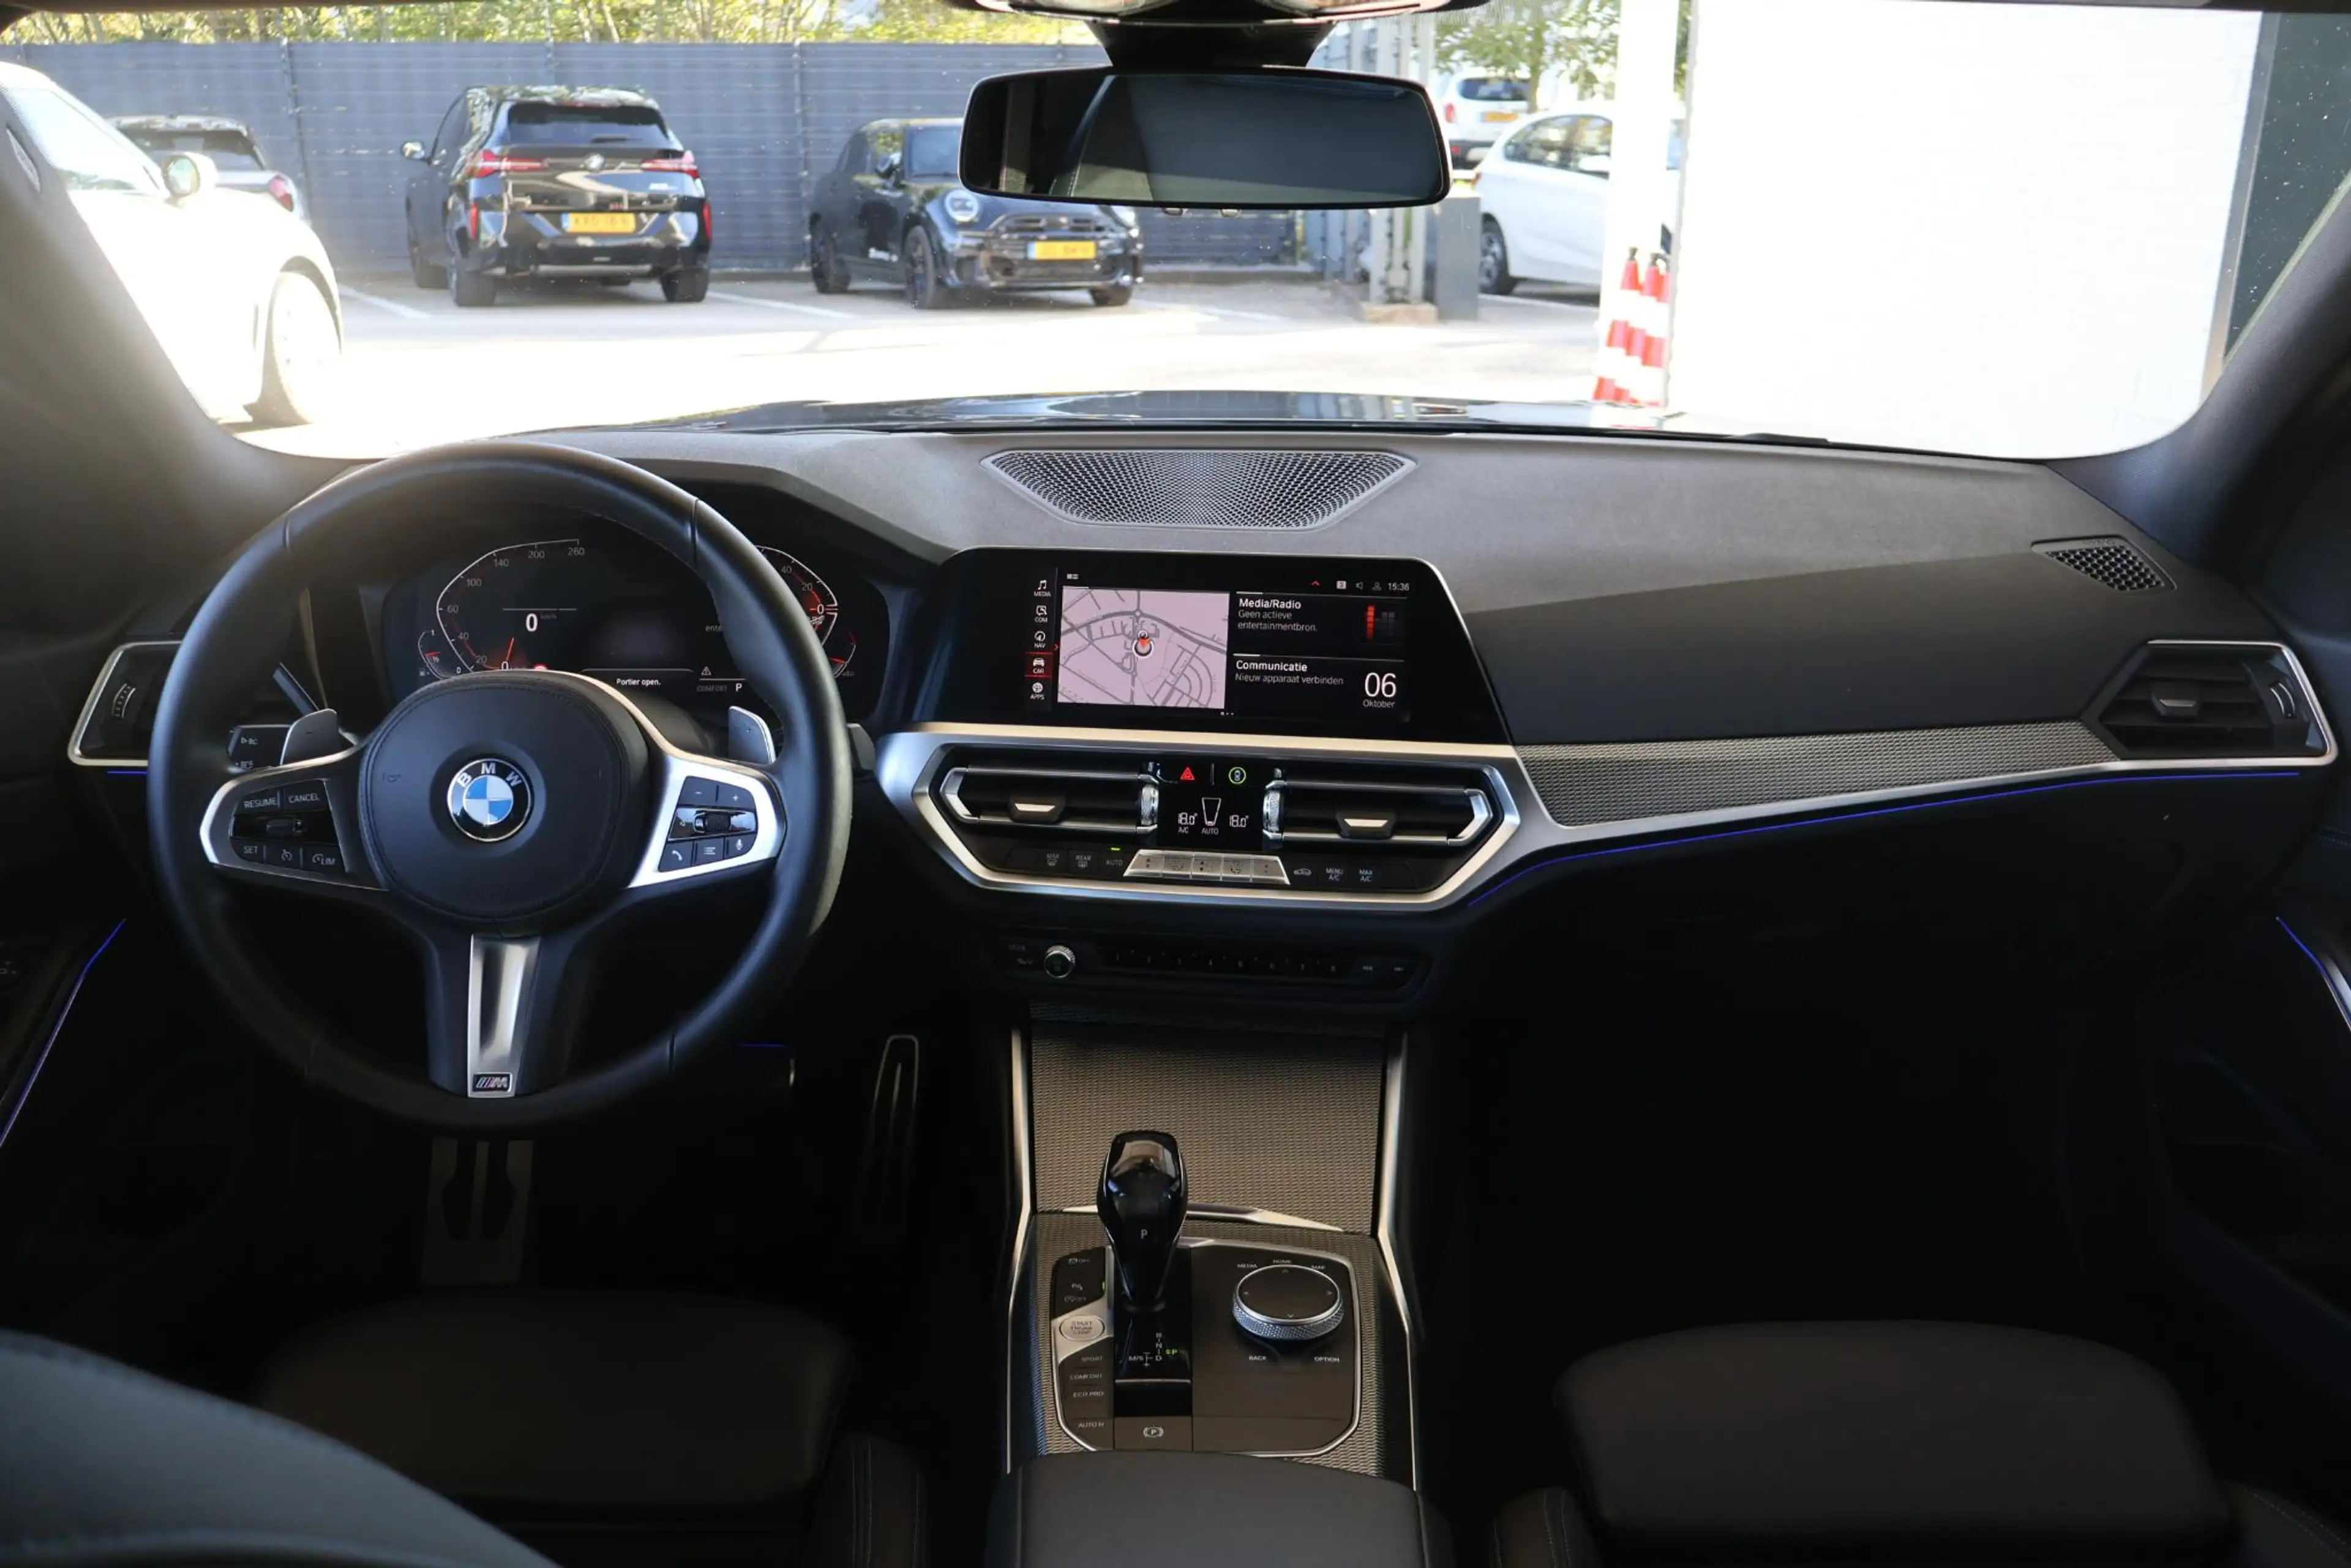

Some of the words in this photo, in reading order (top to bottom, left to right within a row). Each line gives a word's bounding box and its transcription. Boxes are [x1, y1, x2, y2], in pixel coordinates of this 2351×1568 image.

[568, 547, 585, 556] 260
[817, 604, 824, 614] 0
[1239, 598, 1302, 609] Media/Radio
[1238, 610, 1261, 618] Geen
[1262, 610, 1292, 619] actieve
[525, 613, 538, 632] 0
[1237, 621, 1318, 632] entertainmentbron.
[501, 661, 509, 670] 0
[1236, 660, 1308, 672] Communicatie
[1262, 675, 1299, 683] apparaat
[1302, 676, 1344, 685] verbinden
[1365, 672, 1397, 697] 06
[1363, 699, 1395, 708] Oktober
[456, 762, 523, 788] BMW
[244, 797, 277, 809] RESUME
[288, 793, 321, 803] CANCEL
[243, 846, 258, 854] SET
[1141, 1229, 1148, 1240] P
